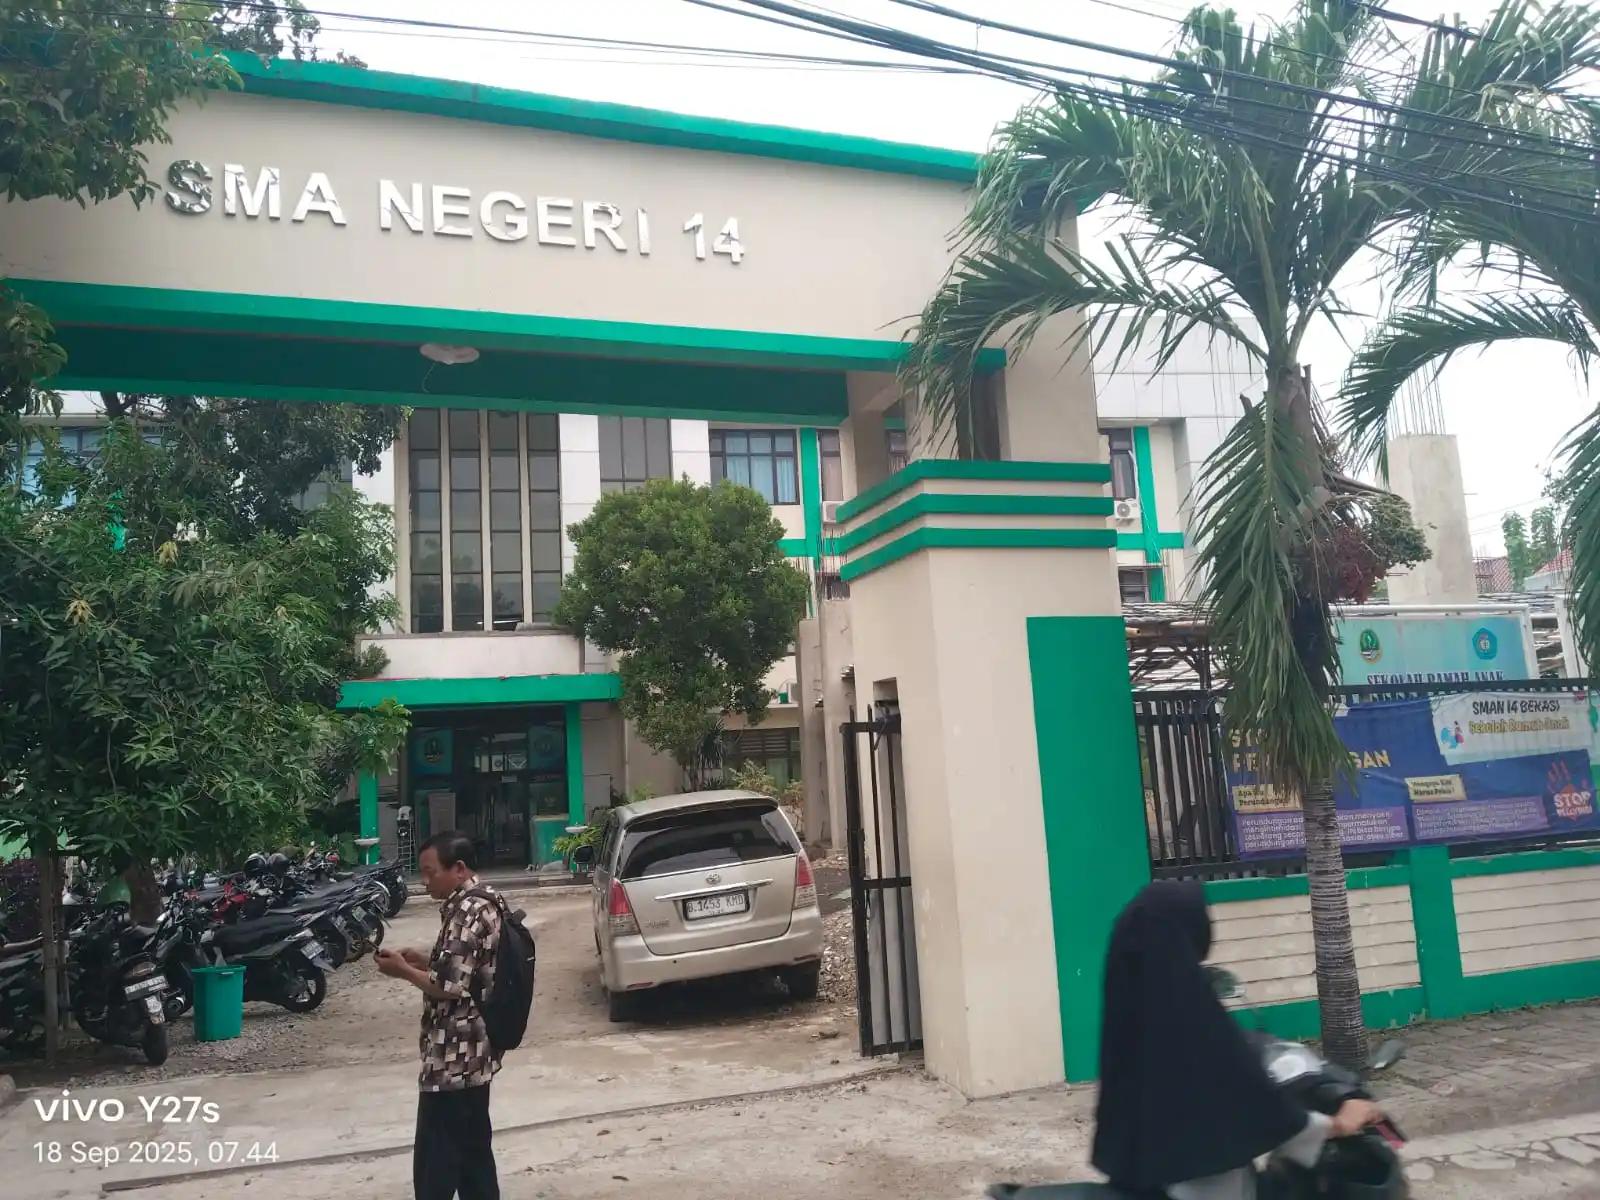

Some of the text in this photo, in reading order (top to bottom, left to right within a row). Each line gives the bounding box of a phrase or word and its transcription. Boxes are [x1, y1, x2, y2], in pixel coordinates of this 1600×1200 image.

[164, 158, 746, 264] SMA NEGERI 14
[1472, 699, 1560, 715] SMAN 14 BEKASI
[1553, 791, 1591, 808] STOP
